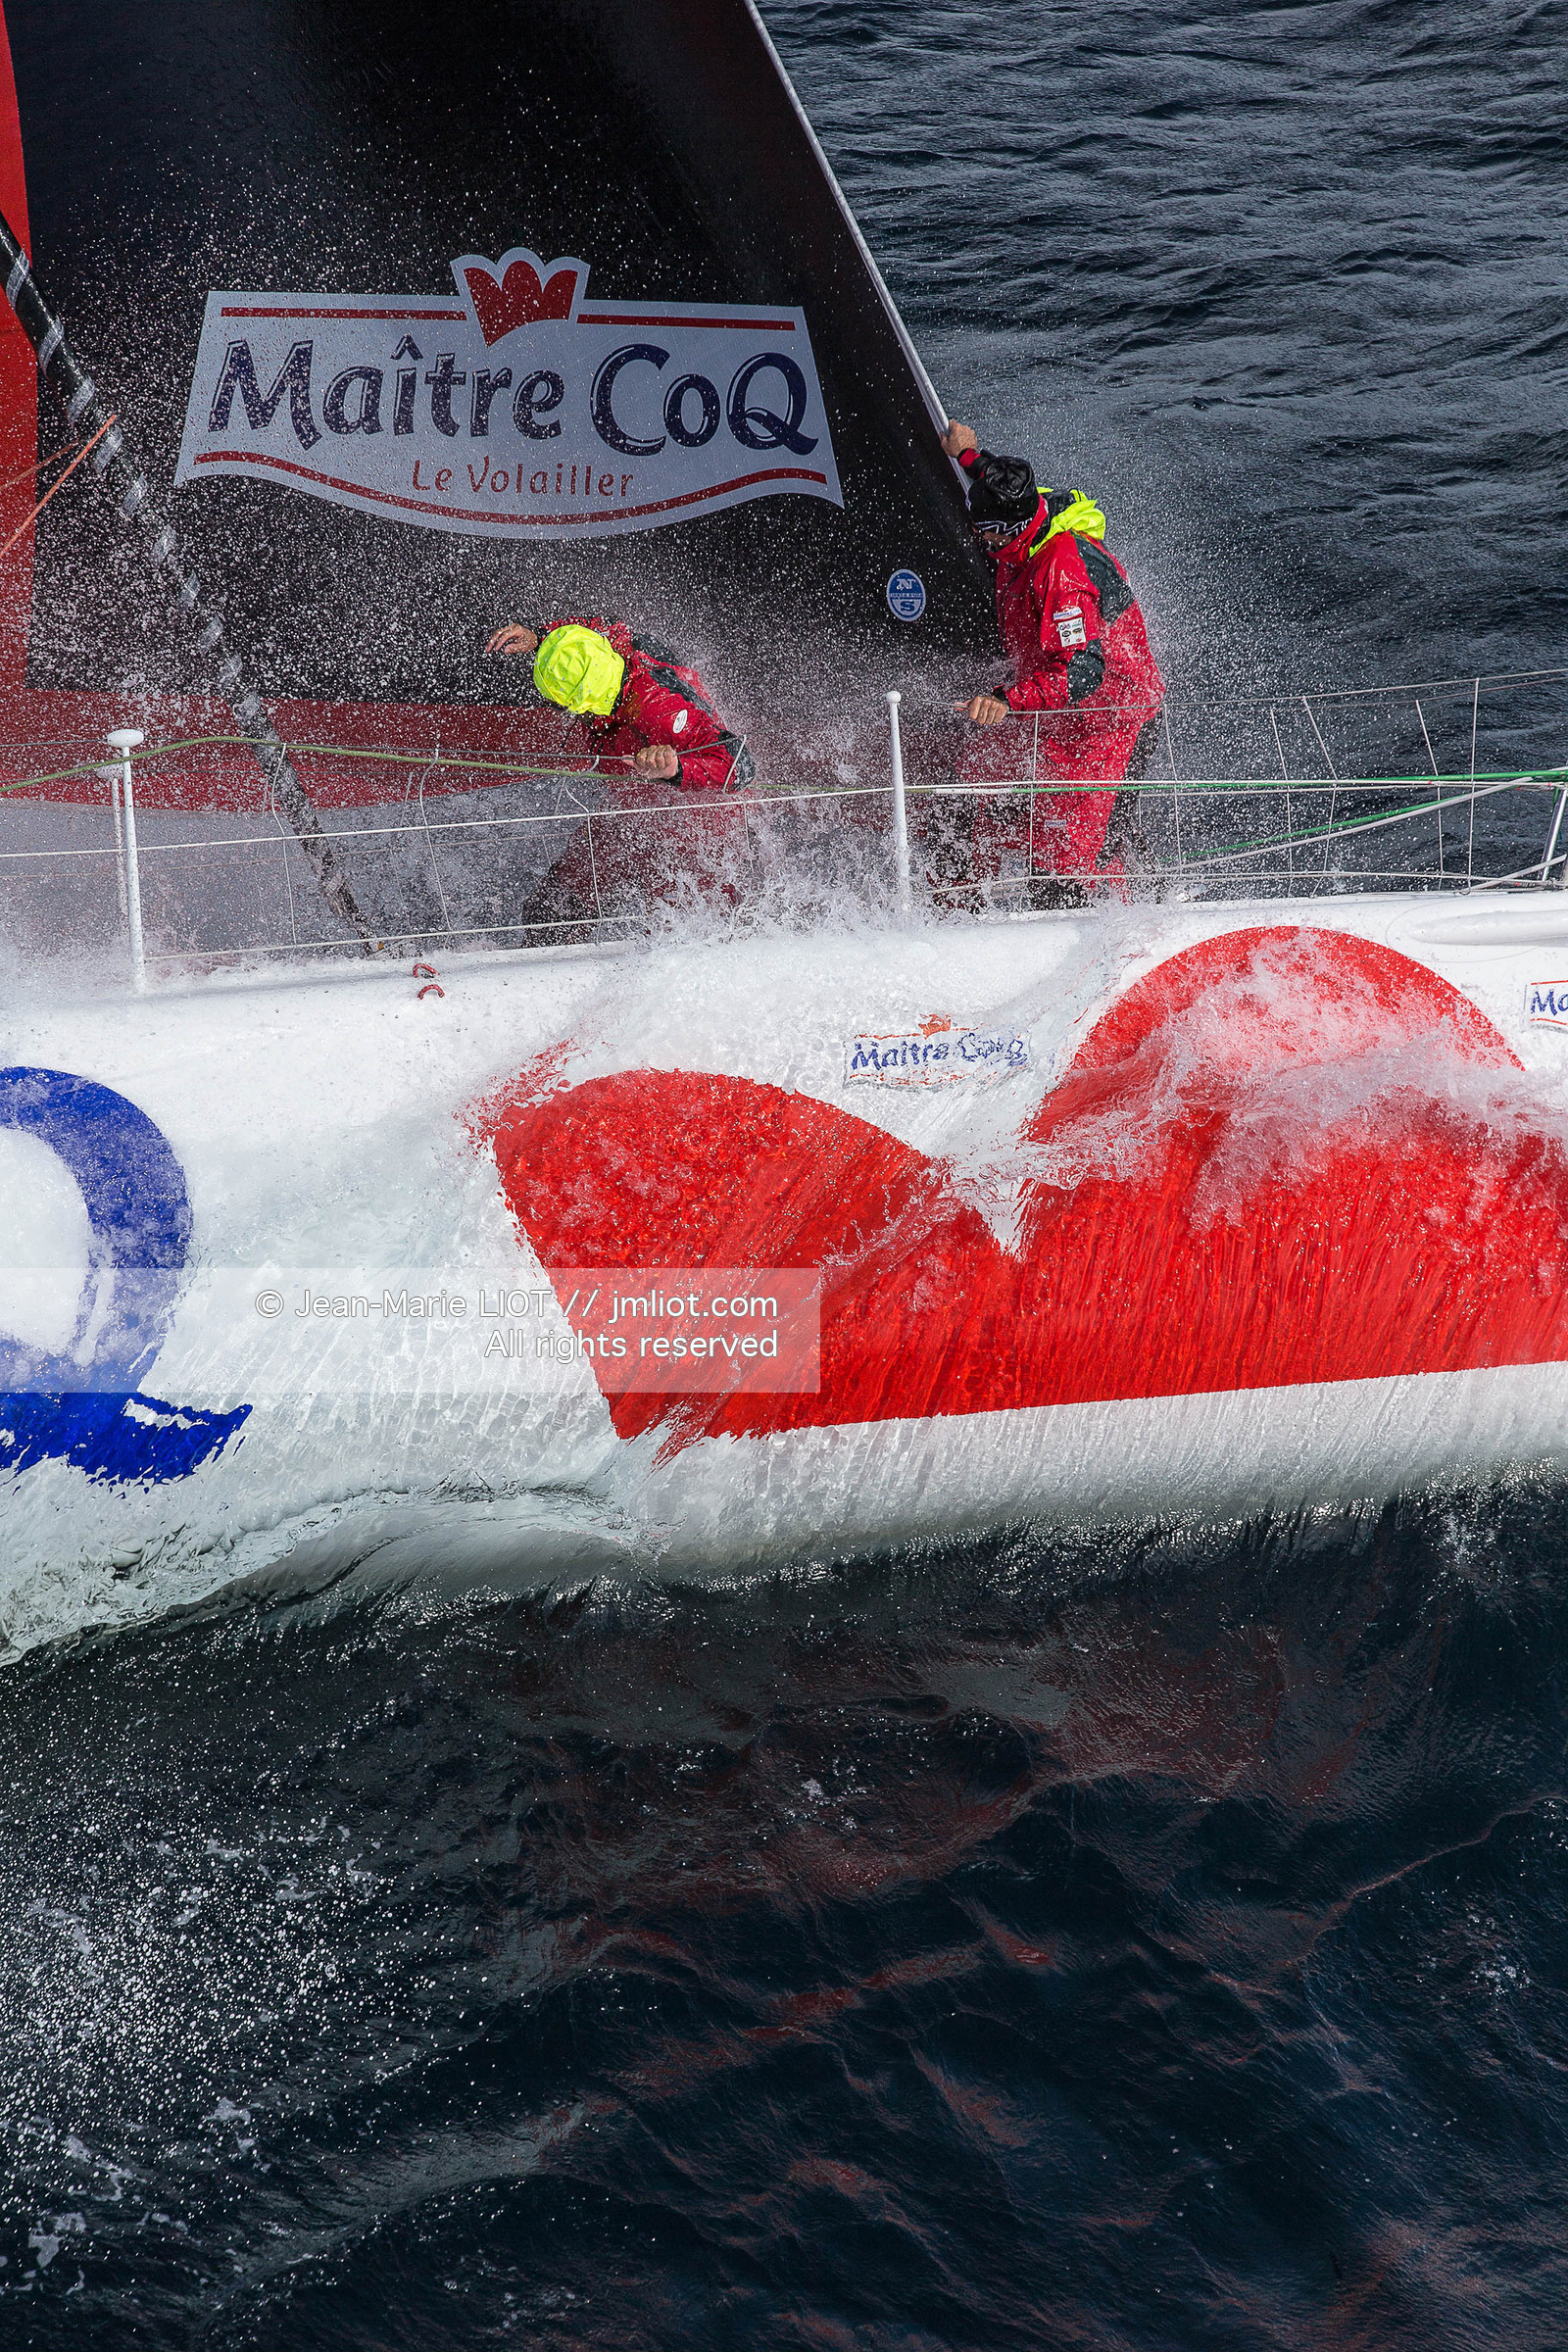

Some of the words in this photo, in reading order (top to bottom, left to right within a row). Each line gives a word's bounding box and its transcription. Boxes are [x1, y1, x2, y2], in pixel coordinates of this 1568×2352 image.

[208, 334, 565, 451] Maître
[589, 343, 819, 456] CoQ
[413, 460, 453, 492] Le
[466, 455, 634, 497] Volailler
